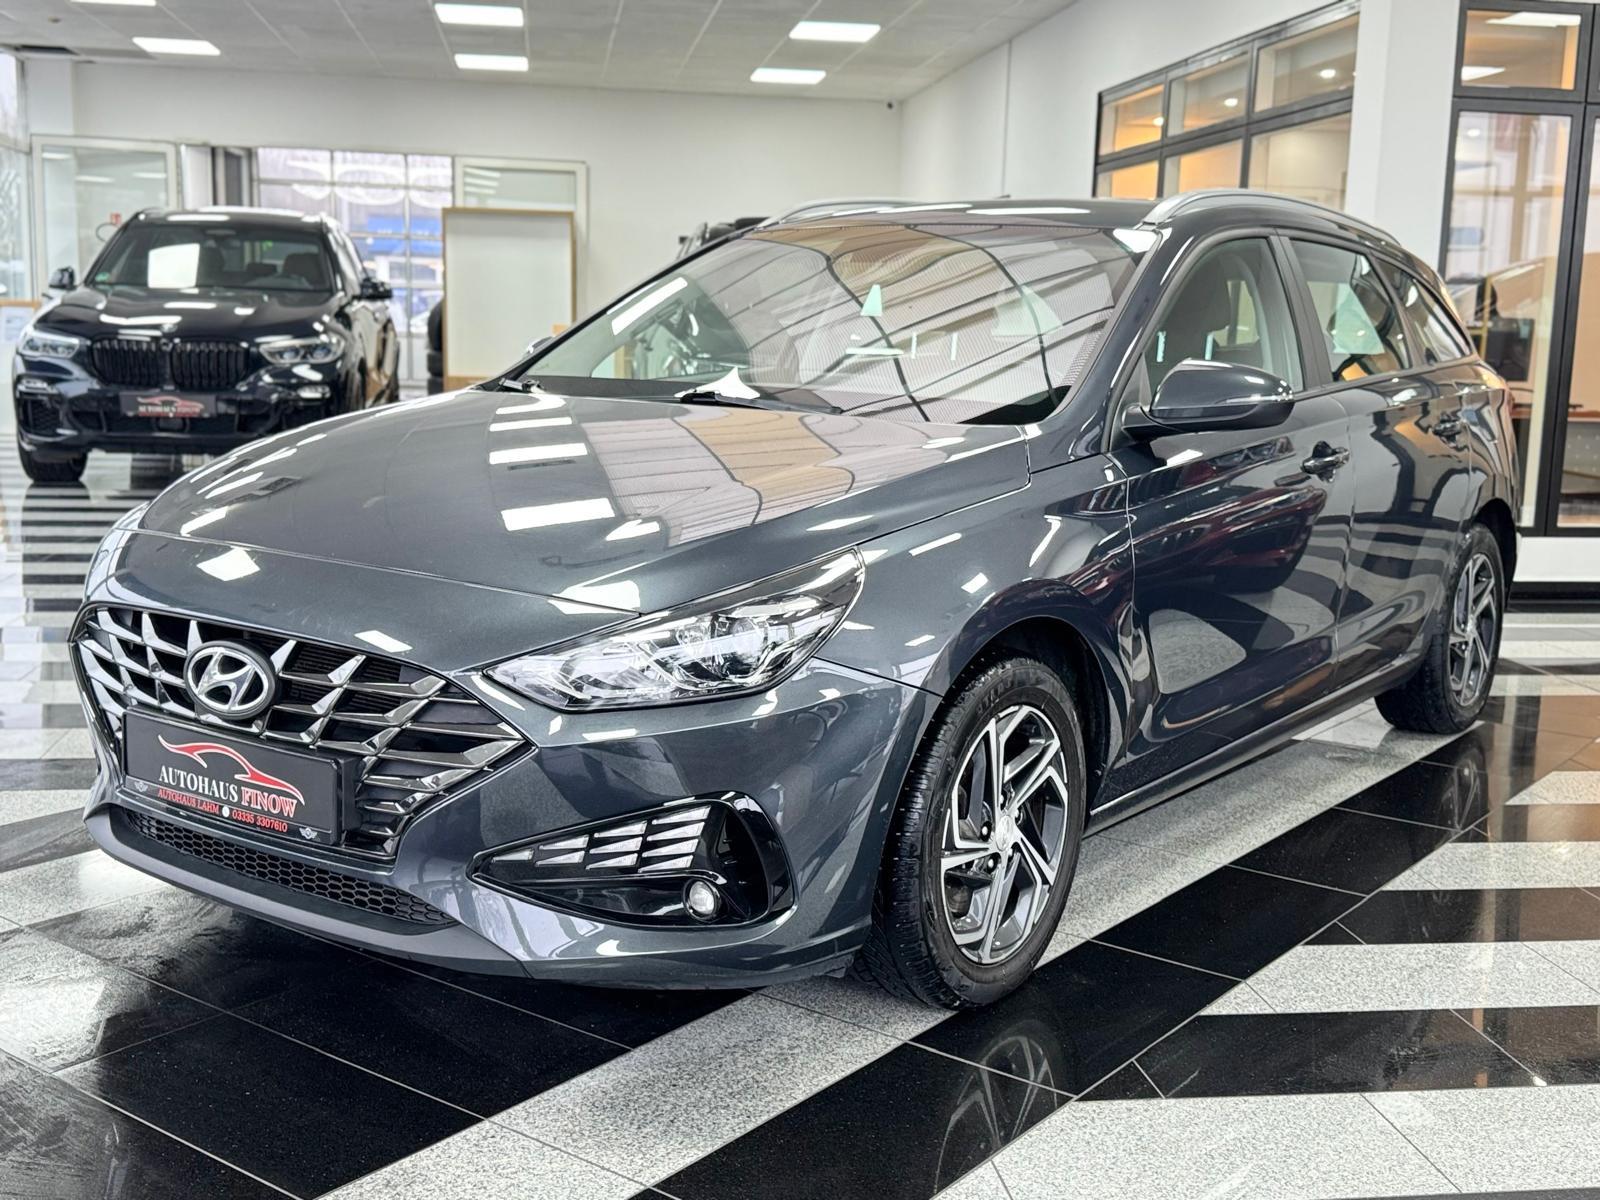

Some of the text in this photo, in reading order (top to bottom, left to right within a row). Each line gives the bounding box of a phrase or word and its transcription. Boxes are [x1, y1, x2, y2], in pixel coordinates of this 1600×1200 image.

[157, 788, 288, 833] AUTOHAUS LAHM 03335 3307610
[158, 765, 297, 818] AUTOHAUS FINOW
